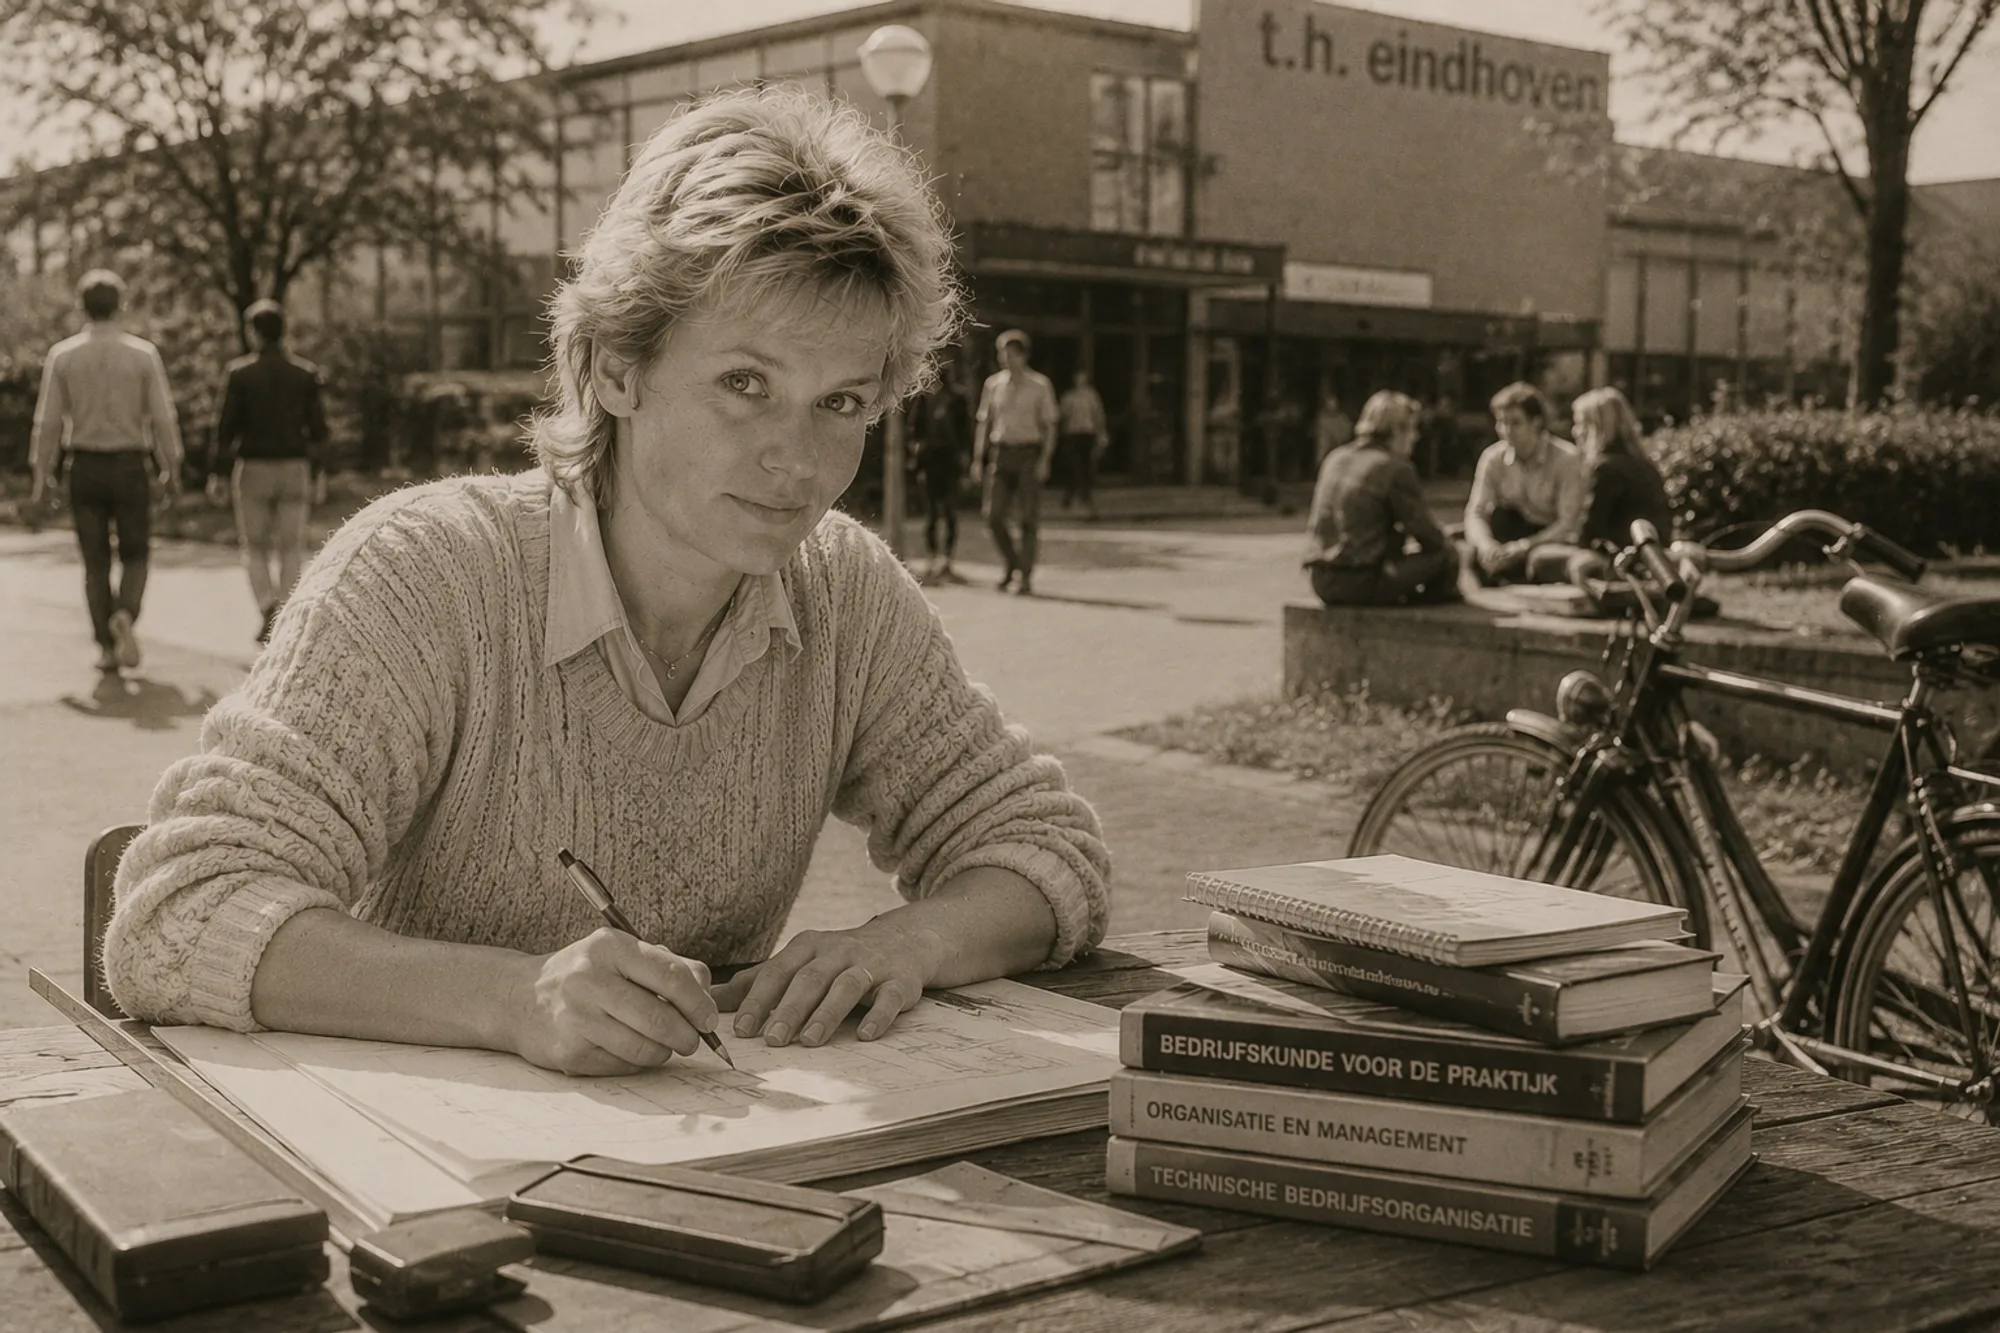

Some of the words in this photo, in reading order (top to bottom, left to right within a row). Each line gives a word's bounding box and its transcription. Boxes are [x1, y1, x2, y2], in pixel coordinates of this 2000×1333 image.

[1259, 10, 1348, 77] t.h.
[1367, 30, 1600, 112] eindhoven
[1160, 1033, 1334, 1072] BEDRIJFSKUNDE
[1341, 1052, 1403, 1079] VOOR
[1410, 1060, 1440, 1083] DE
[1447, 1063, 1558, 1096] PRAKTIJK
[1146, 1100, 1276, 1133] ORGANISATIE
[1283, 1116, 1310, 1138] EN
[1317, 1121, 1468, 1156] MANAGEMENT
[1150, 1165, 1278, 1201] TECHNISCHE
[1284, 1184, 1534, 1238] BEDRIJFSORGANISATIE
